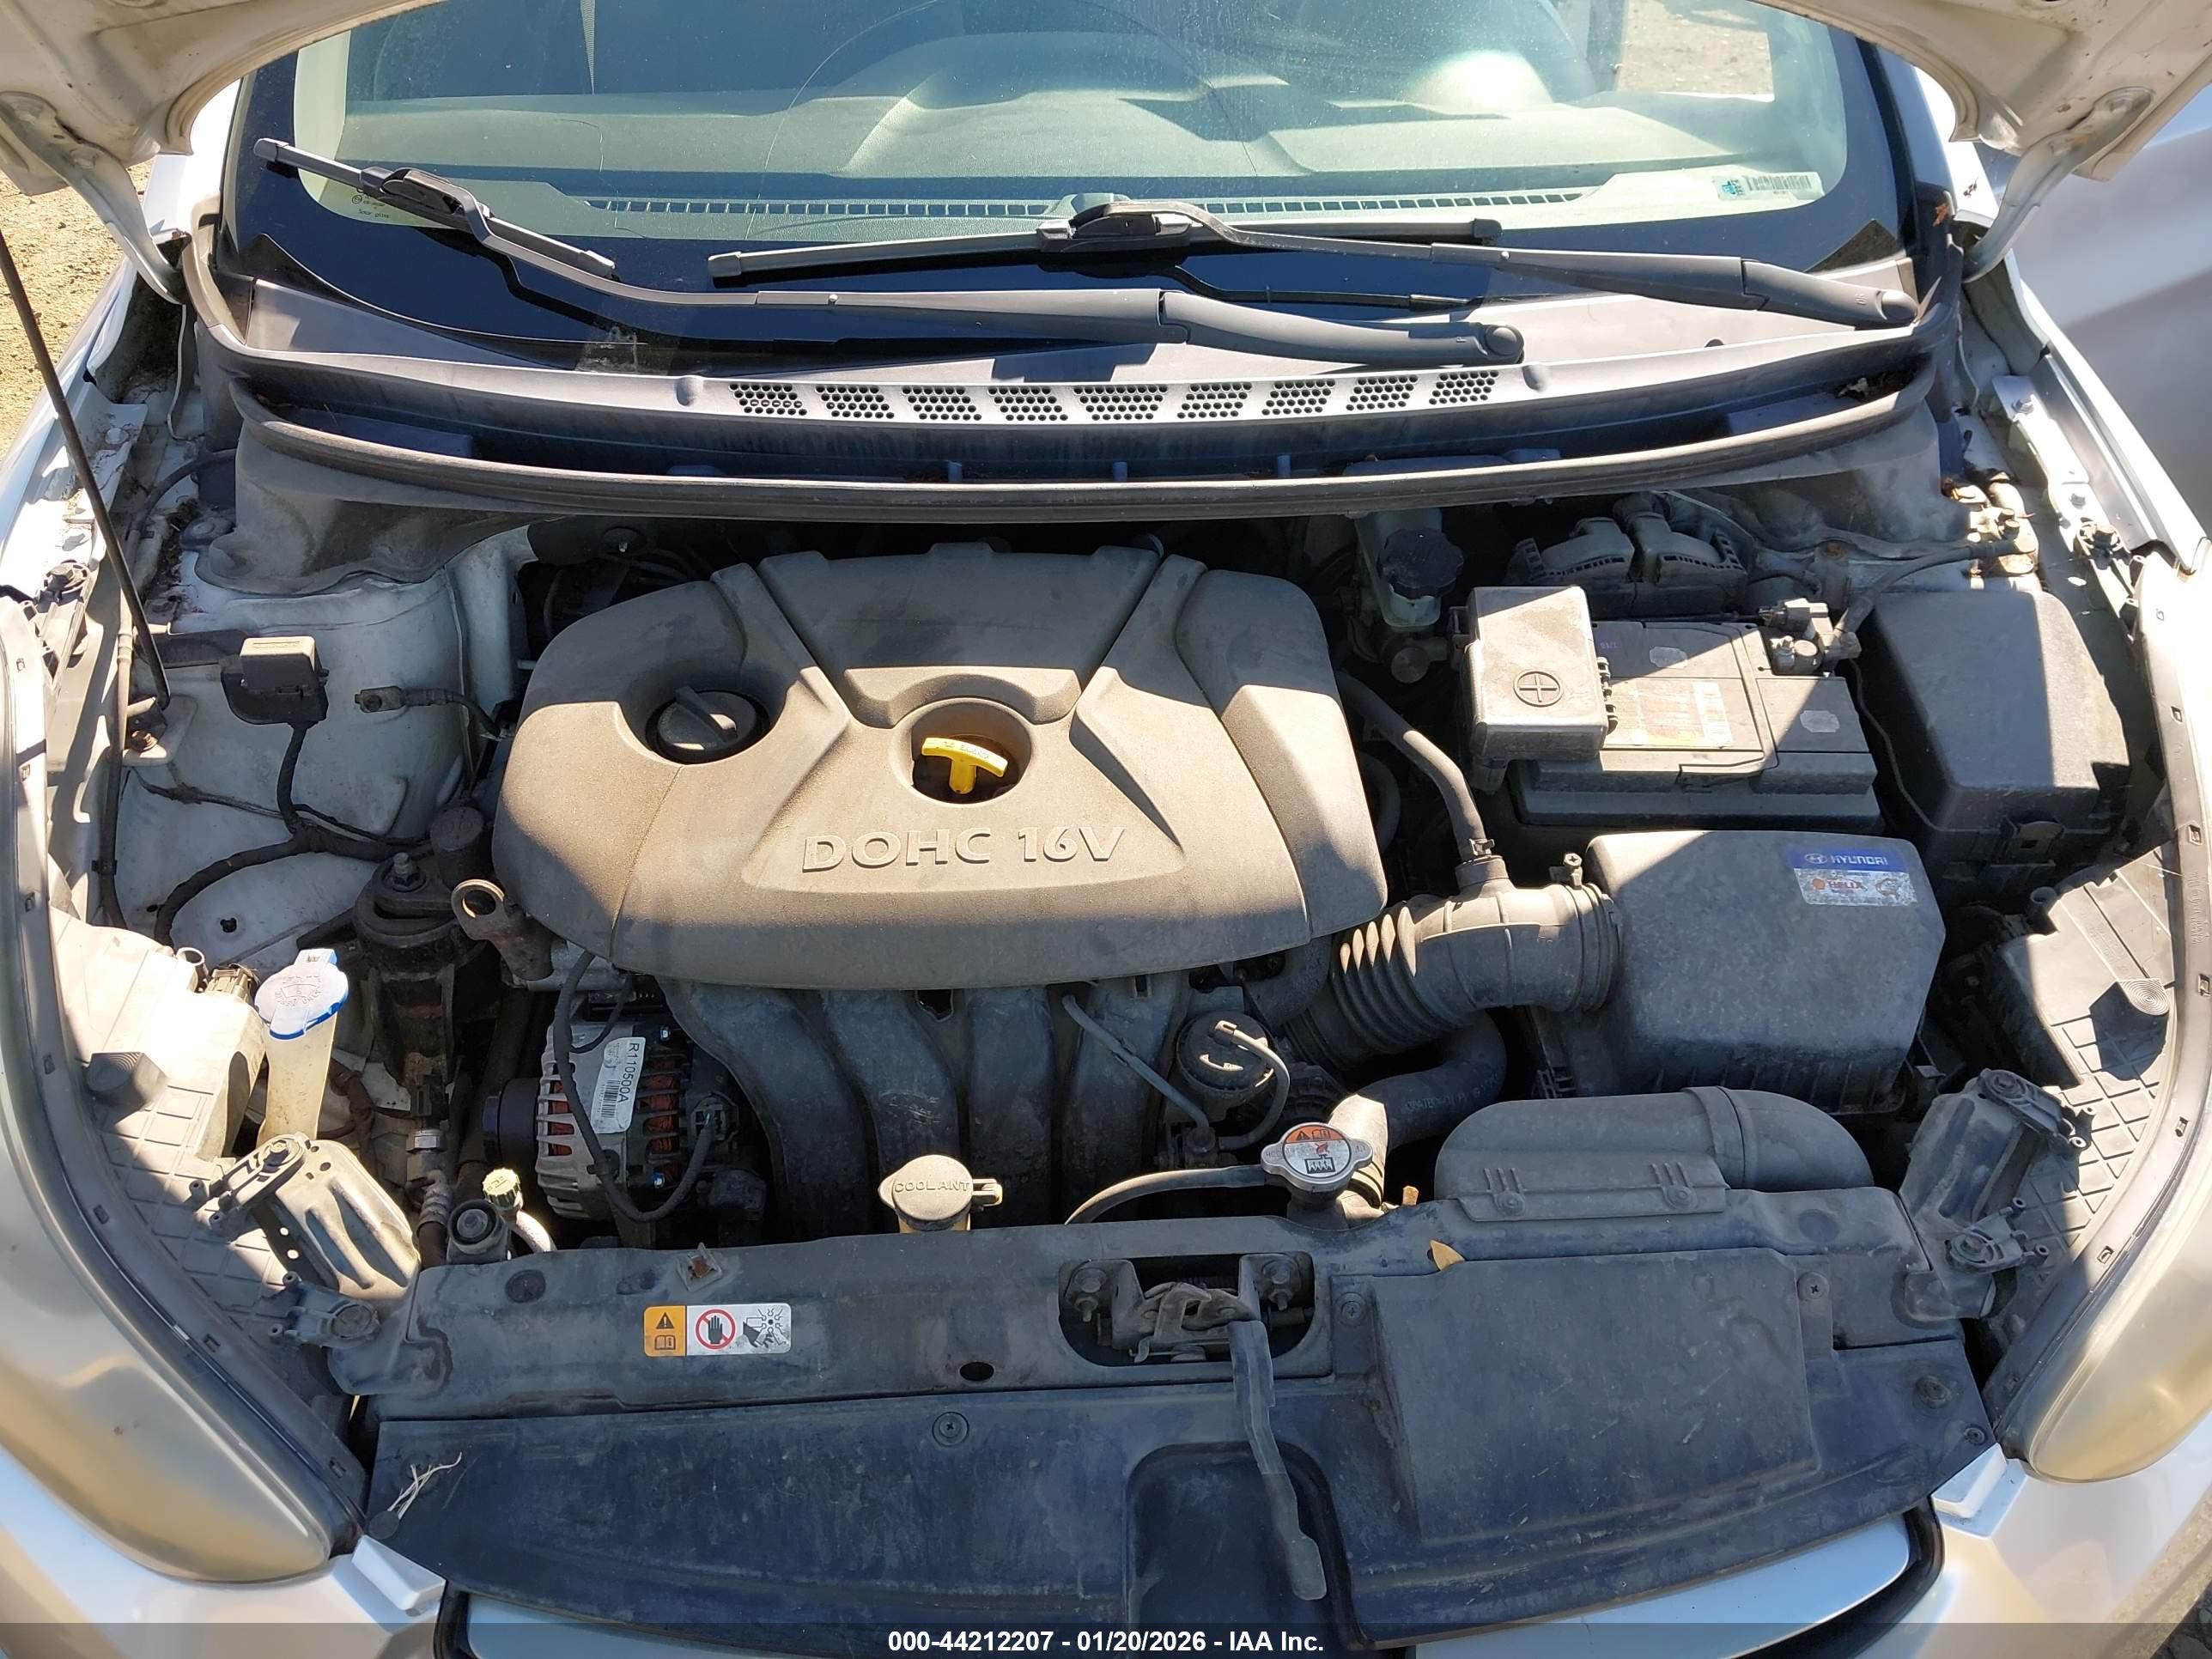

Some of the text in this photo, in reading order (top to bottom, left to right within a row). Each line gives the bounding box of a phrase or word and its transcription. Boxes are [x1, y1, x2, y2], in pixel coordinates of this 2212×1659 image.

[802, 826, 1125, 873] DOHC 16V
[1832, 854, 1888, 866] HYUNDAI
[617, 1042, 640, 1103] R110500A
[895, 1181, 970, 1193] COOLANT
